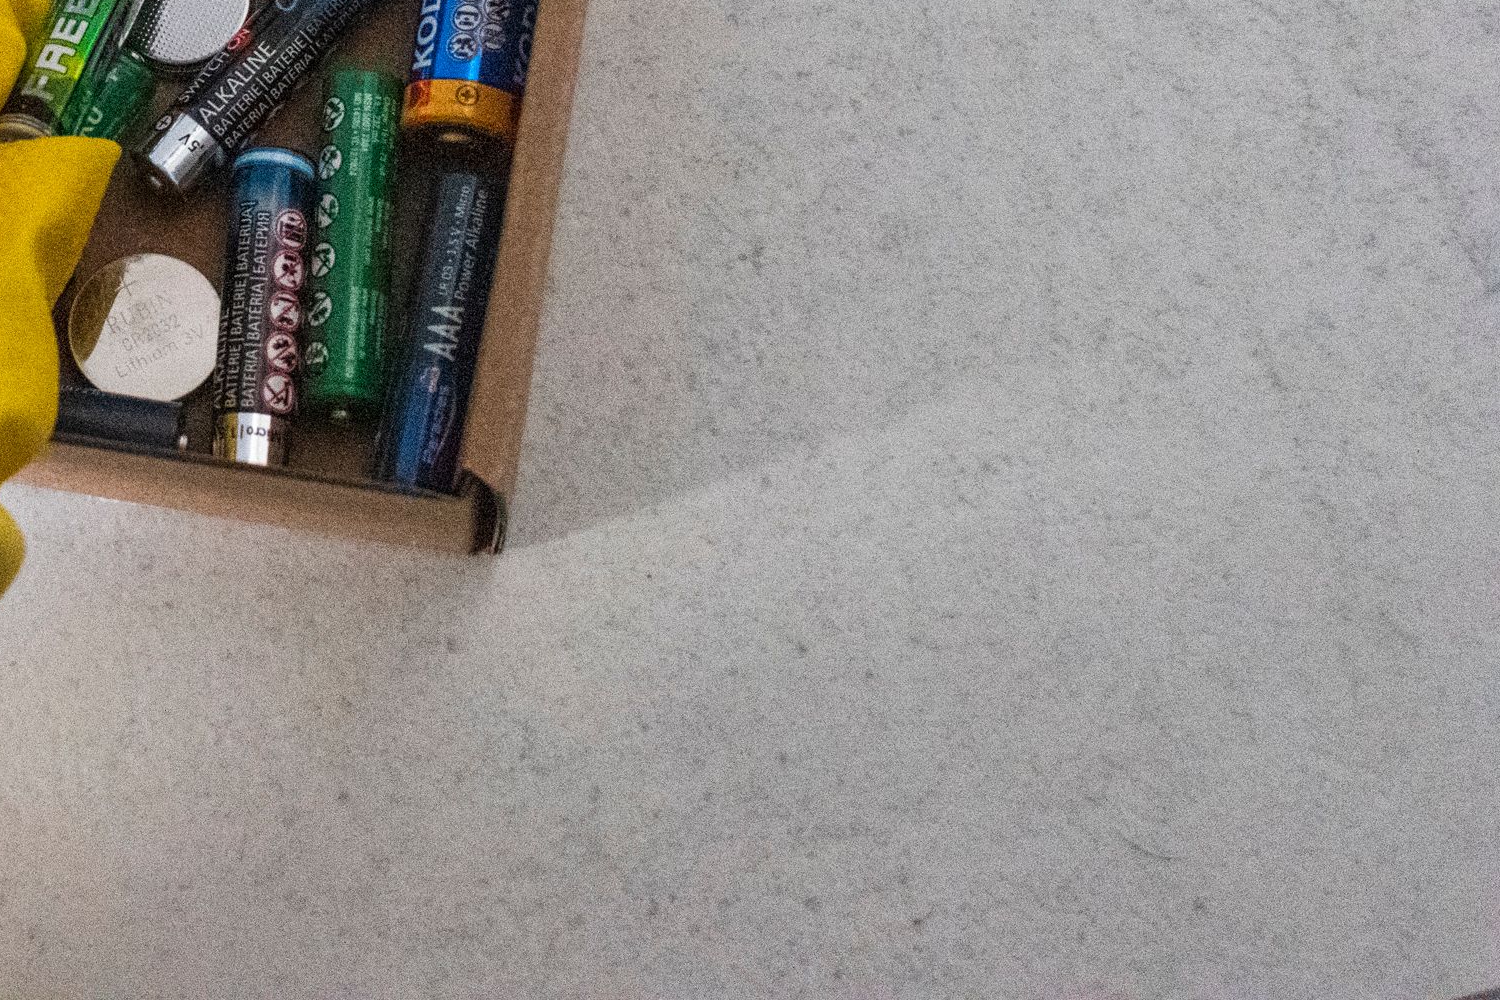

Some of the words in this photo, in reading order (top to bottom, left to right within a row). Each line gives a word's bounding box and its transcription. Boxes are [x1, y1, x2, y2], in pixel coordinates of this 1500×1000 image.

[194, 39, 277, 126] ALKALINE
[210, 81, 265, 138] BATTERIE
[260, 34, 309, 85] BATERIE
[453, 184, 470, 218] Micro
[463, 187, 489, 250] Alkaline
[252, 210, 271, 274] БАТЕРИЯ
[230, 277, 248, 335] BATERIE
[453, 253, 475, 301] Power
[113, 336, 179, 379] Lithium
[179, 323, 207, 346] 3V
[120, 312, 182, 353] CR2032
[421, 301, 465, 362] AAA
[224, 343, 242, 408] BATTERIE
[240, 348, 259, 408] BATERIA
